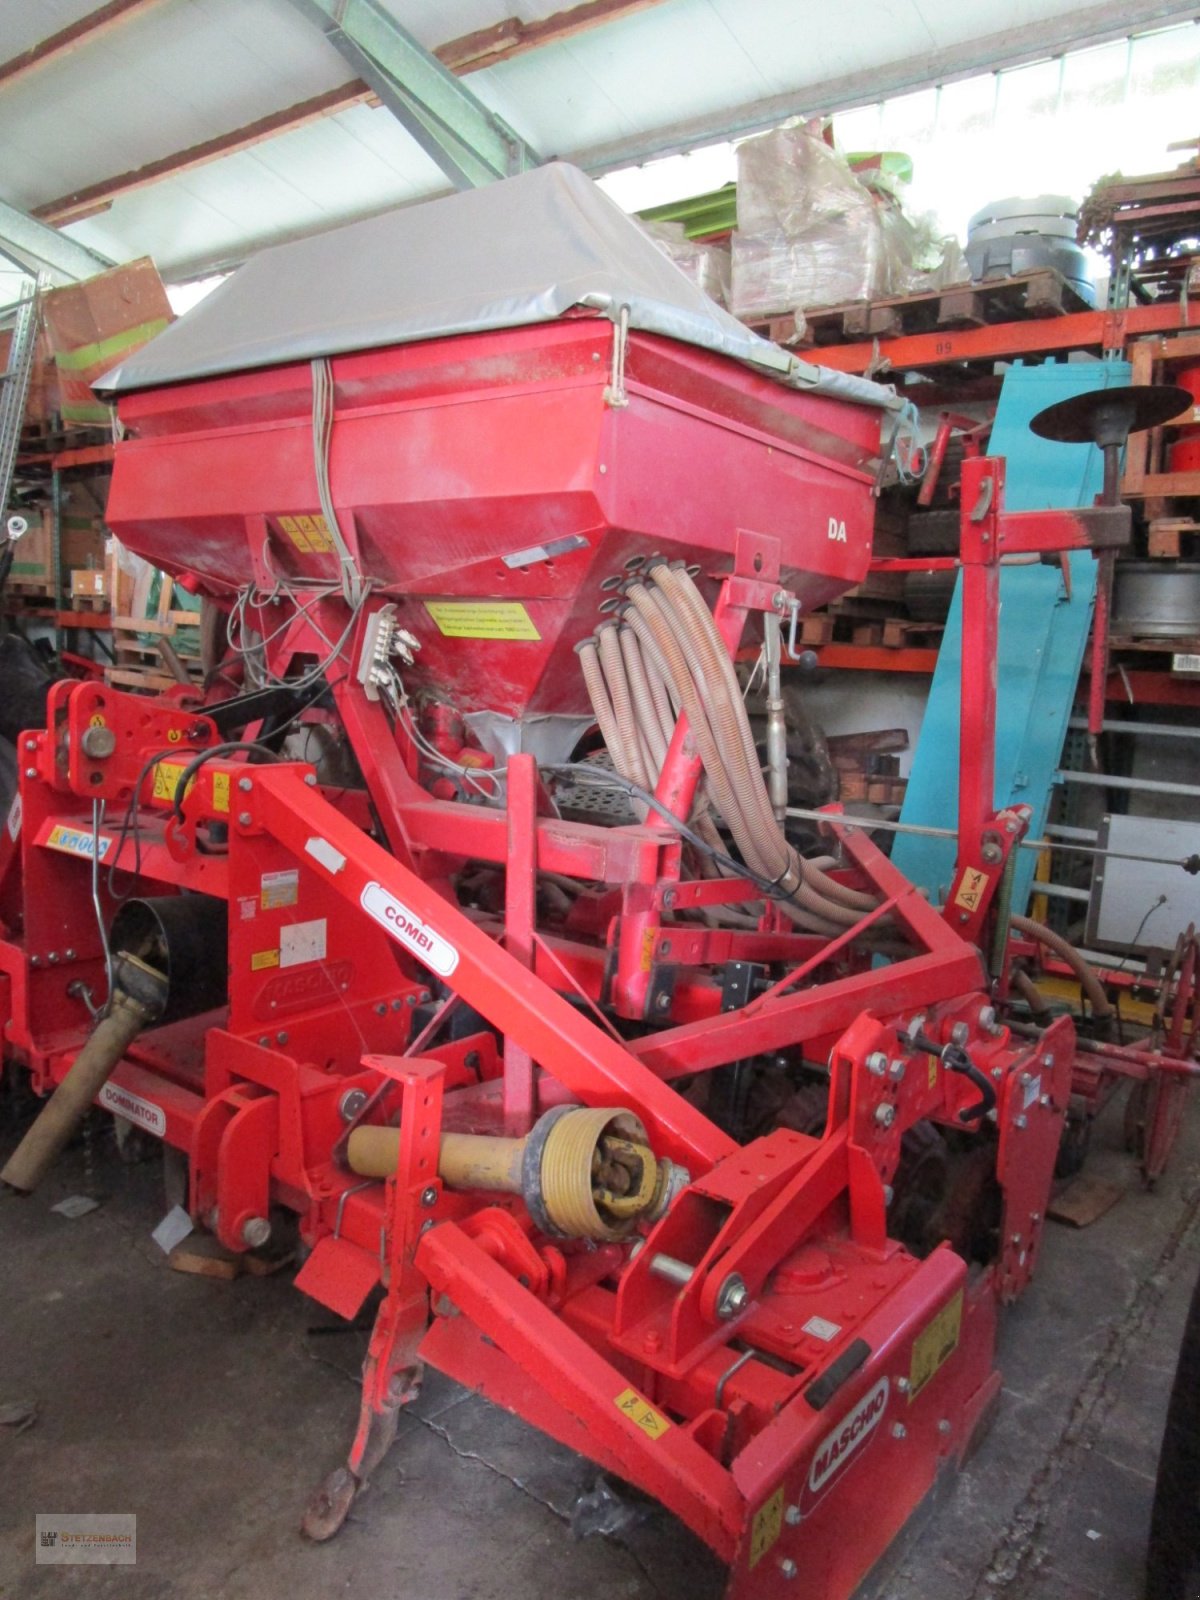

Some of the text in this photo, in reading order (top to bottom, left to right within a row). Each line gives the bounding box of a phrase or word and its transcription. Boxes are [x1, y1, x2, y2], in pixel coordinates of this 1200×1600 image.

[828, 517, 847, 543] DA
[384, 905, 434, 952] COMBI
[106, 1088, 158, 1126] DOMINATOR
[813, 1388, 885, 1484] MASCHIO
